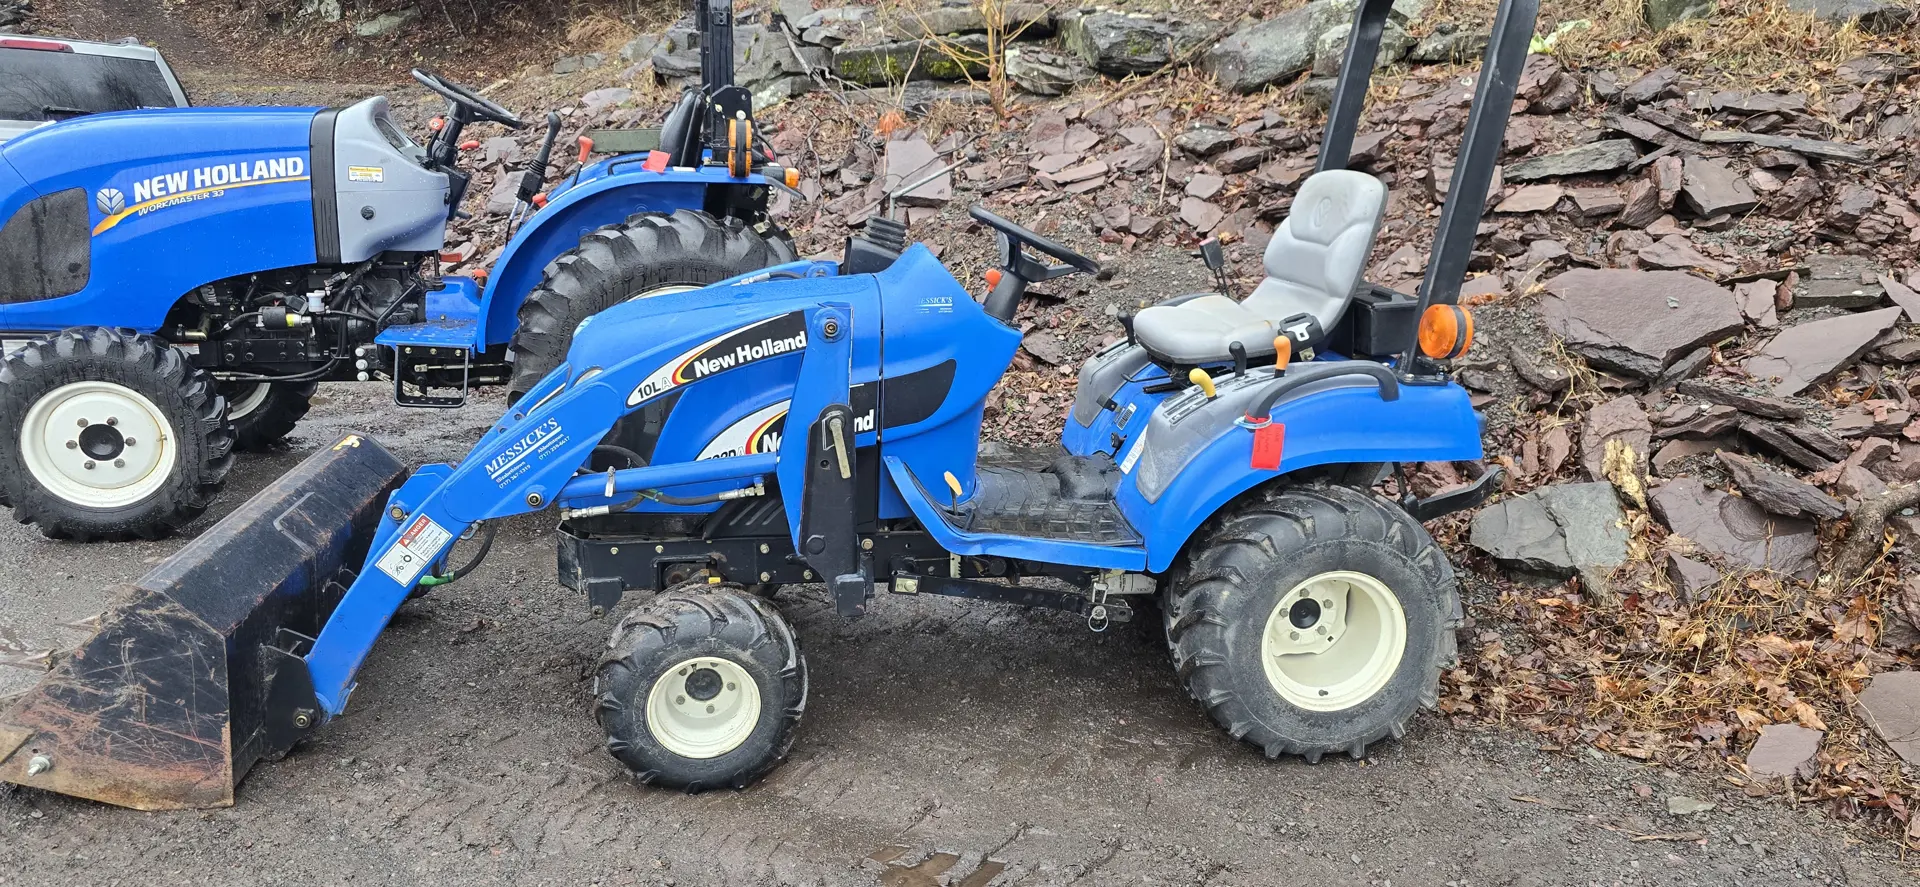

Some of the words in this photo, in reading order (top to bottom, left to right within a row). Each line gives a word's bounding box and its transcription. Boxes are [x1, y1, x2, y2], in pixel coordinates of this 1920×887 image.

[133, 169, 189, 203] NEW
[193, 156, 304, 188] HOLLAND
[138, 191, 210, 217] WORKMASTER
[211, 189, 225, 199] 33
[693, 351, 736, 379] New
[736, 330, 808, 365] Holland
[484, 417, 558, 476] MESSICK'S
